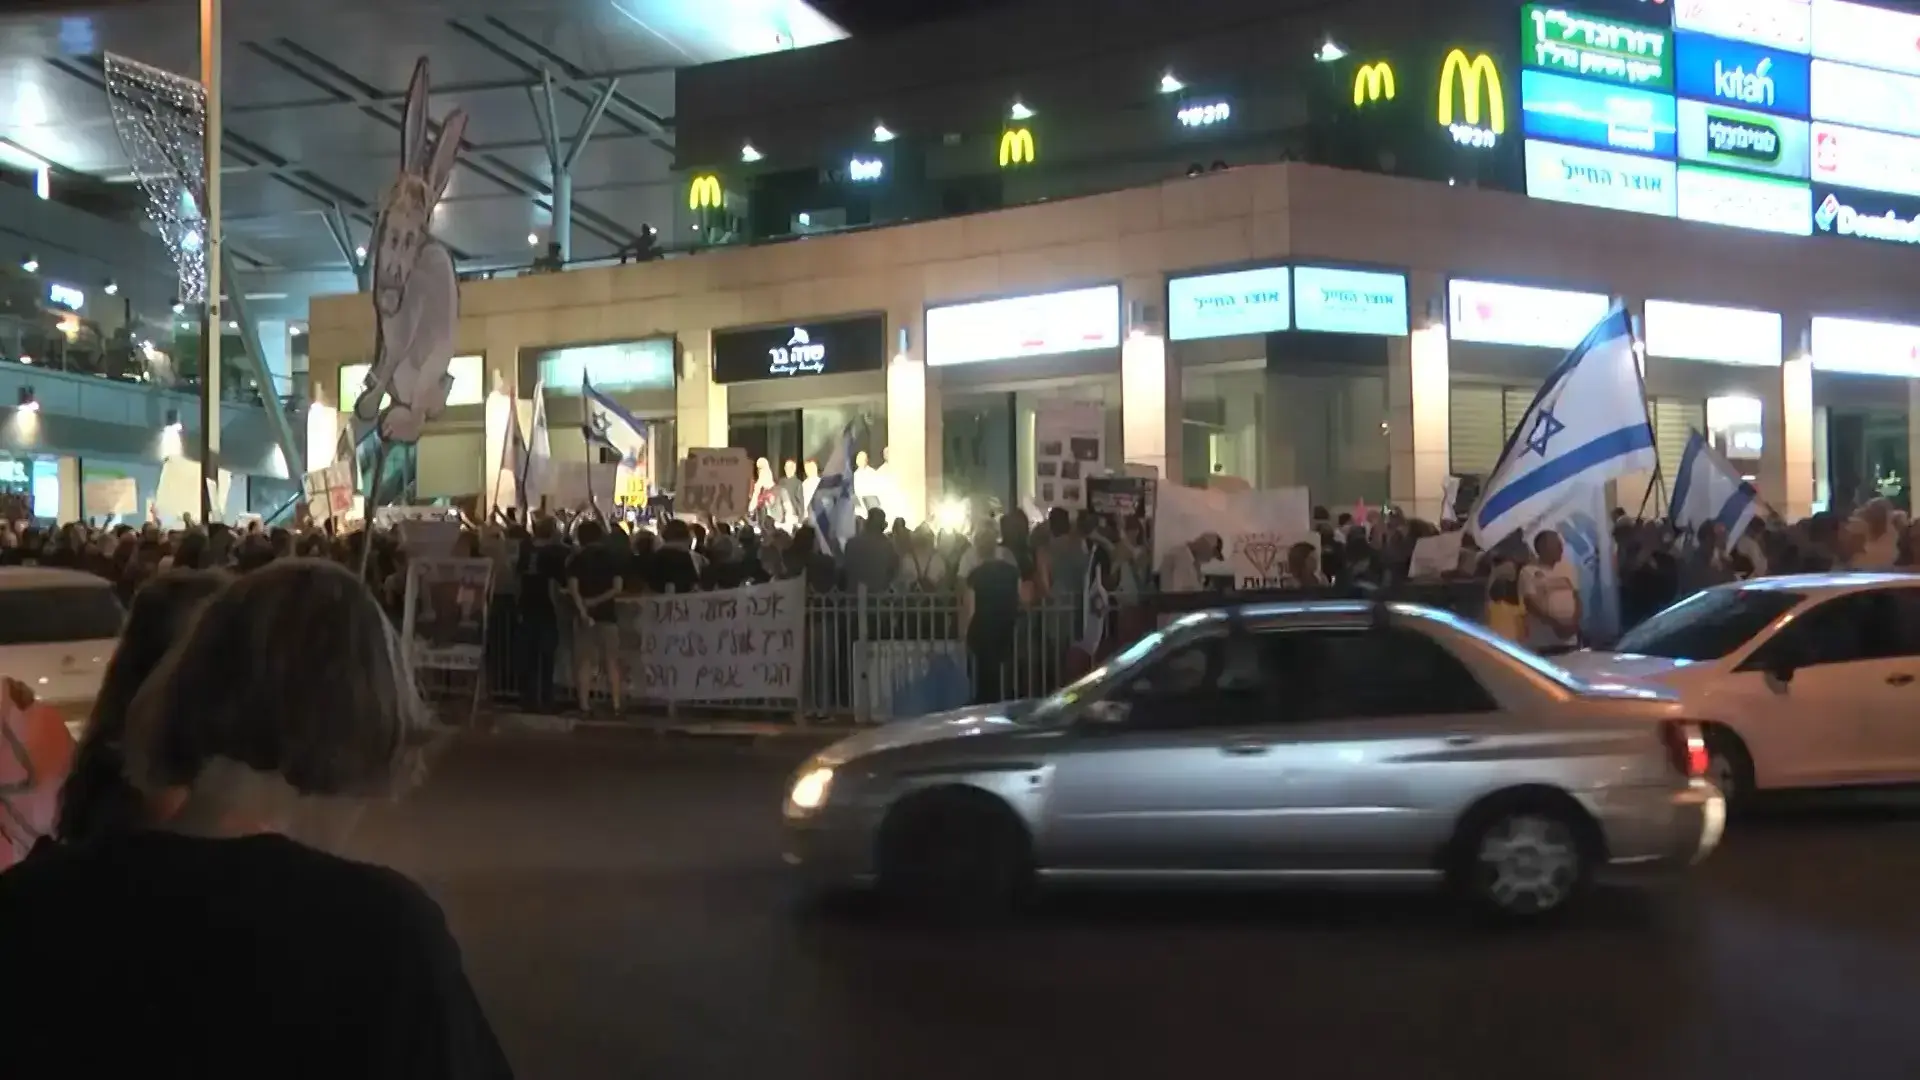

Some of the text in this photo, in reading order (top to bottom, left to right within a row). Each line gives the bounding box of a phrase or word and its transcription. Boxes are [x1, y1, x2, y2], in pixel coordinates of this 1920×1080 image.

[1715, 58, 1774, 106] kitan
[1561, 157, 1662, 192] אוצר החייל
[1194, 291, 1279, 309] אוצר החייל
[1319, 287, 1393, 305] אוצר החייל
